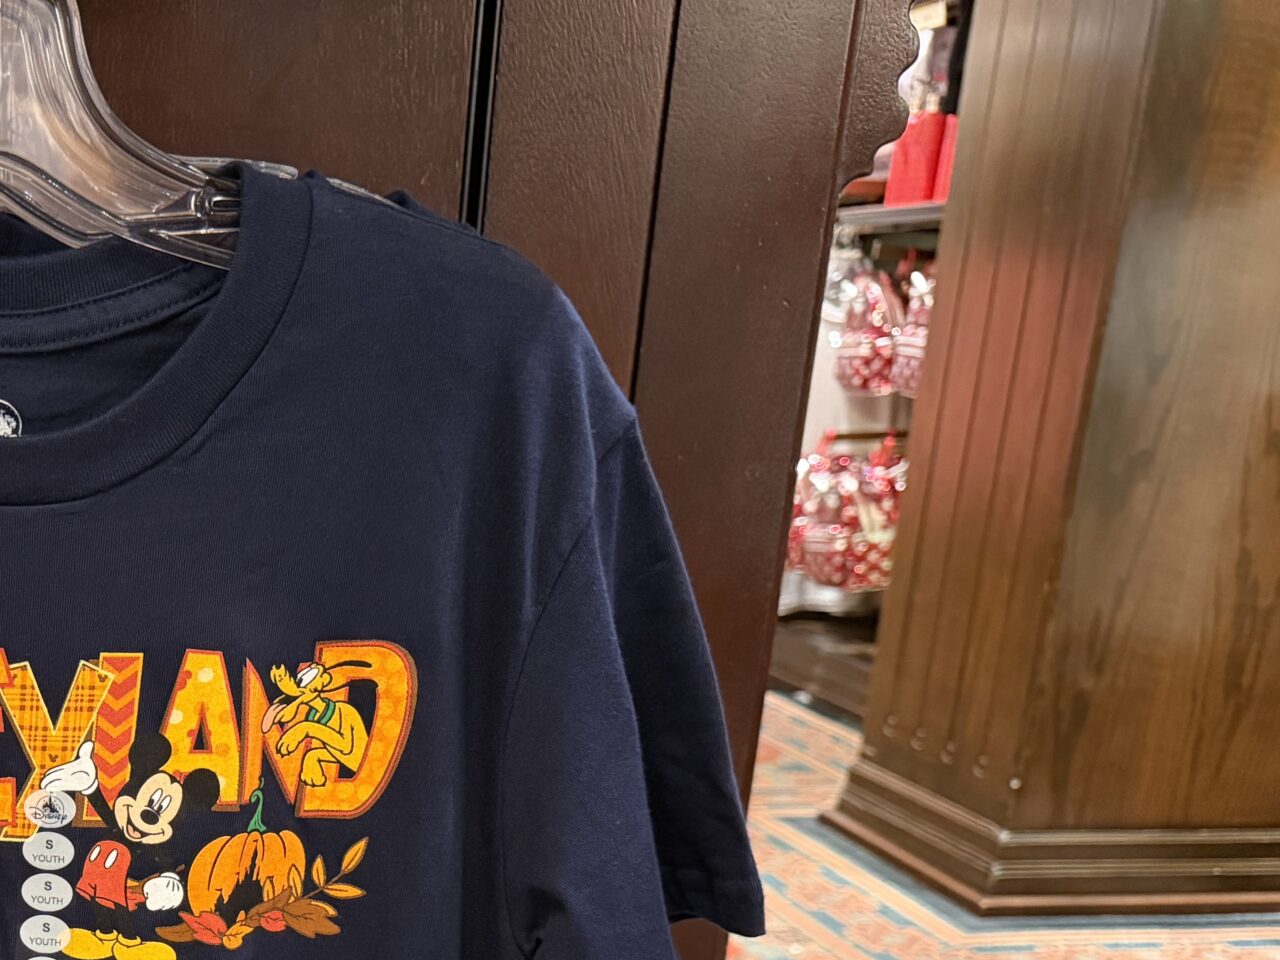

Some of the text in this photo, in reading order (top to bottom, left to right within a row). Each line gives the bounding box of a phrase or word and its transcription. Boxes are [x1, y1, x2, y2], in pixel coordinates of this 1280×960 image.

[45, 839, 53, 850] S
[31, 854, 65, 864] YOUTH
[44, 881, 52, 891] S
[30, 896, 64, 906] YOUTH
[42, 922, 51, 933] S
[29, 937, 62, 947] YOUTH
